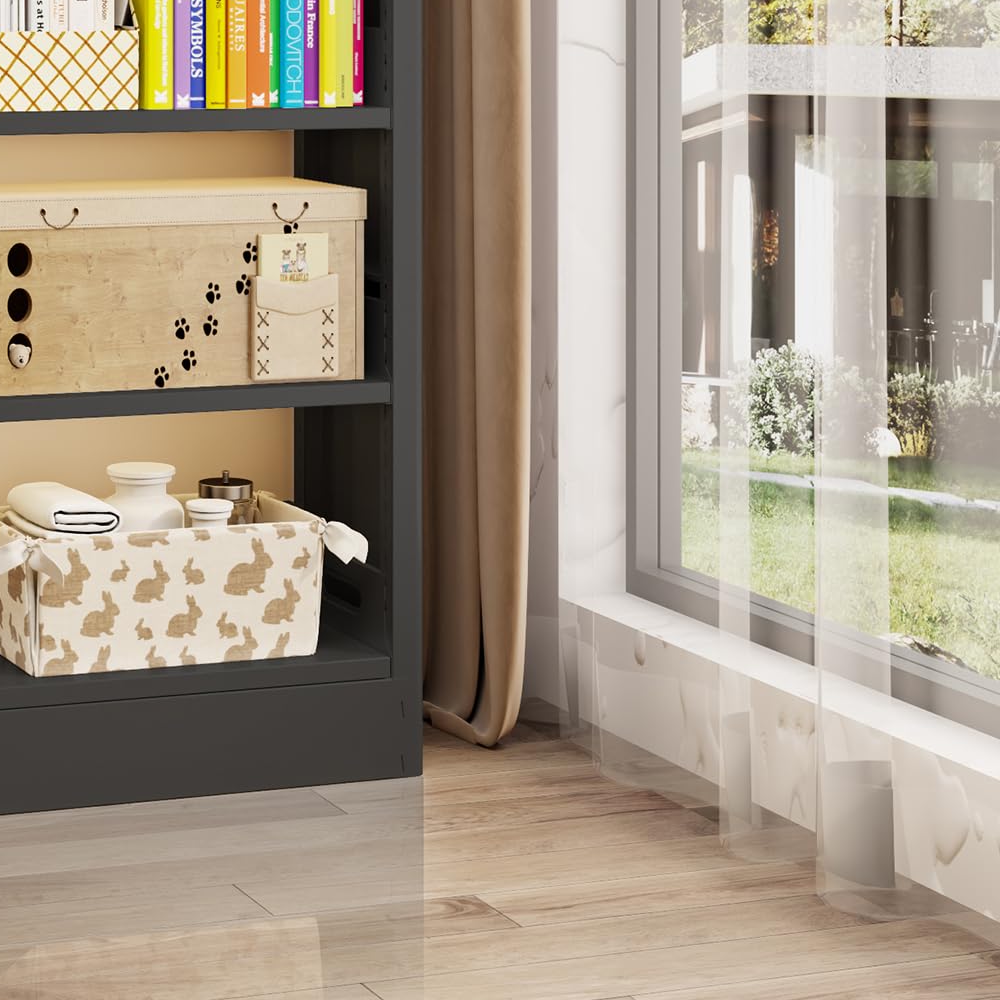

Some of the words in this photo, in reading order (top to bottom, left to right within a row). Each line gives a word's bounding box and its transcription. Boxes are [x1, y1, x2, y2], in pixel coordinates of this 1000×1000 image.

[307, 0, 317, 11] in
[36, 8, 44, 19] at
[307, 13, 317, 49] France
